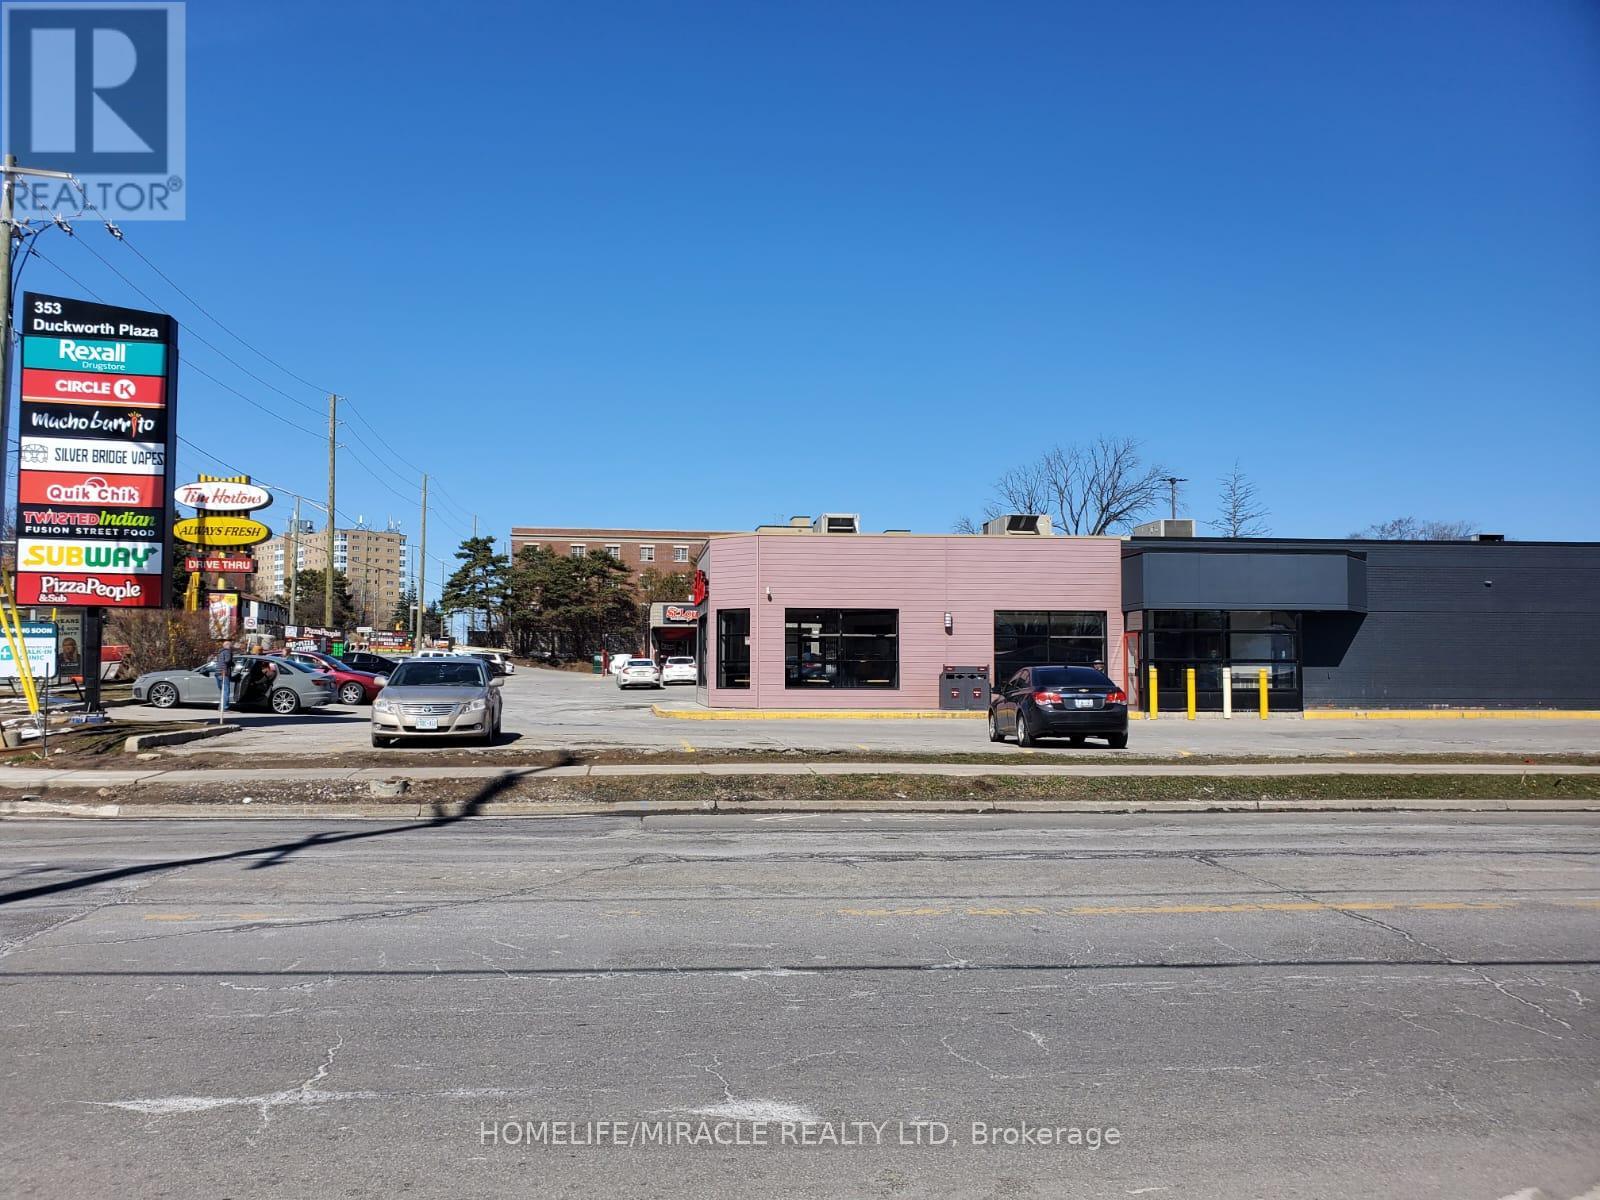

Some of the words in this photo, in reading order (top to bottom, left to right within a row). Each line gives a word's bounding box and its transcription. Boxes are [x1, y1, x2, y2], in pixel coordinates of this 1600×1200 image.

[34, 302, 62, 314] 353
[33, 319, 115, 335] Duckworth
[119, 324, 159, 337] Plaza
[59, 339, 126, 362] Rexall
[82, 361, 126, 371] Drugstore
[55, 380, 111, 394] CIRCLE
[55, 448, 88, 463] SILVER
[92, 449, 127, 464] BRIDGE
[131, 451, 164, 465] VAPES
[49, 486, 91, 501] Quik
[98, 488, 138, 502] Chik
[183, 488, 211, 504] Tim
[212, 487, 262, 505] Hortons
[99, 510, 156, 526] Indian
[25, 526, 70, 534] FUSION
[76, 527, 119, 536] STREET
[123, 529, 155, 537] FOOD
[180, 526, 224, 536] ALWAYS
[224, 526, 261, 537] FRESH
[23, 546, 159, 568] SUBWAY
[189, 560, 220, 569] DRIVE
[222, 560, 251, 570] THRU
